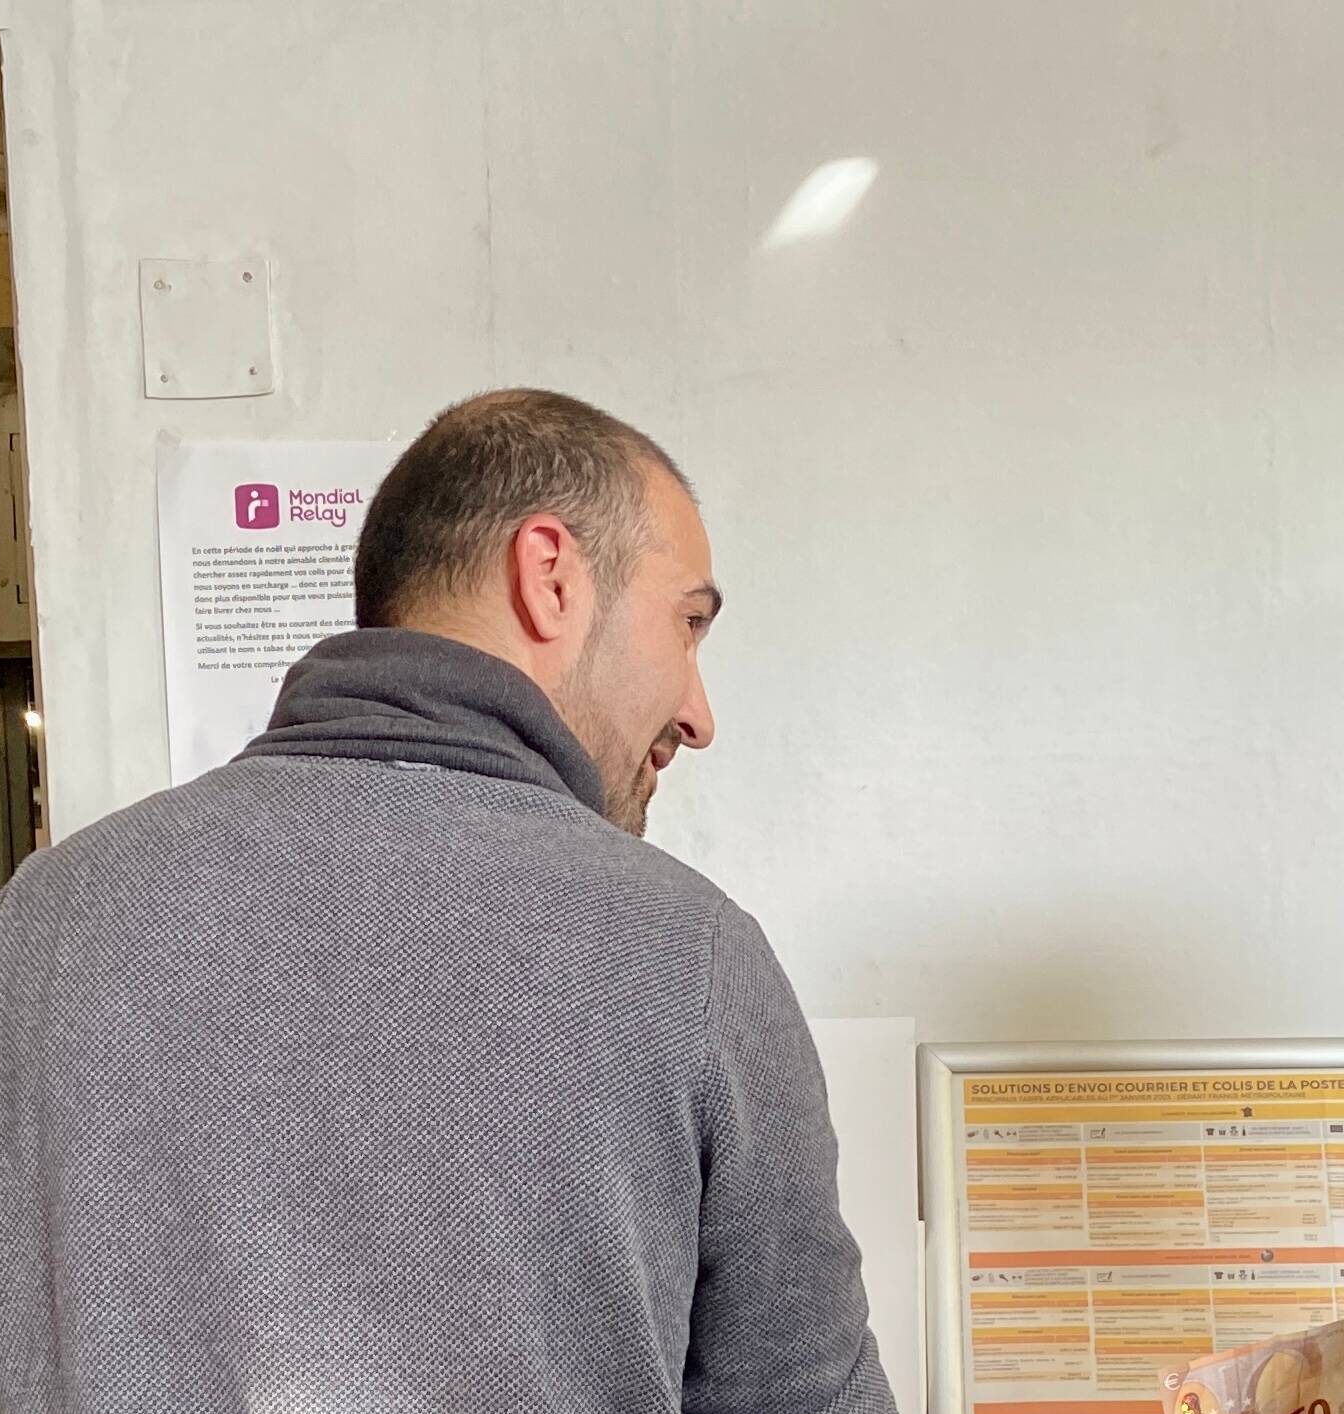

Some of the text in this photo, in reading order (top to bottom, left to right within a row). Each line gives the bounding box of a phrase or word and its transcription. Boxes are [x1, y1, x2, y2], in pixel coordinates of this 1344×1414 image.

[289, 488, 364, 506] Mondial
[290, 506, 347, 528] Relay
[224, 546, 252, 555] période
[266, 545, 282, 553] noël
[284, 546, 296, 555] qui
[297, 545, 333, 554] approche
[319, 556, 351, 564] clientèle
[193, 571, 225, 579] chercher
[249, 570, 292, 579] rapidement
[308, 568, 325, 576] colis
[327, 568, 345, 577] pour
[214, 583, 239, 593] soyons
[253, 582, 289, 591] surcharge
[215, 595, 230, 604] plus
[232, 594, 270, 603] disponible
[272, 593, 290, 603] pour
[291, 594, 306, 602] que
[195, 607, 212, 615] faire
[214, 606, 233, 615] livrer
[235, 606, 252, 614] chez
[224, 621, 259, 630] souhaitez
[319, 619, 333, 627] des
[196, 634, 235, 642] actualités,
[236, 633, 270, 641] n'hésitez
[272, 633, 284, 641] pas
[197, 647, 227, 655] utilisant
[198, 662, 219, 670] Merci
[971, 1083, 1050, 1095] SOLUTIONS
[1056, 1083, 1112, 1094] D'ENVOI
[1116, 1082, 1188, 1093] COURRIER
[1192, 1081, 1209, 1092] ET
[1213, 1080, 1253, 1091] COLIS
[1257, 1080, 1276, 1090] DE
[1280, 1080, 1298, 1090] LA
